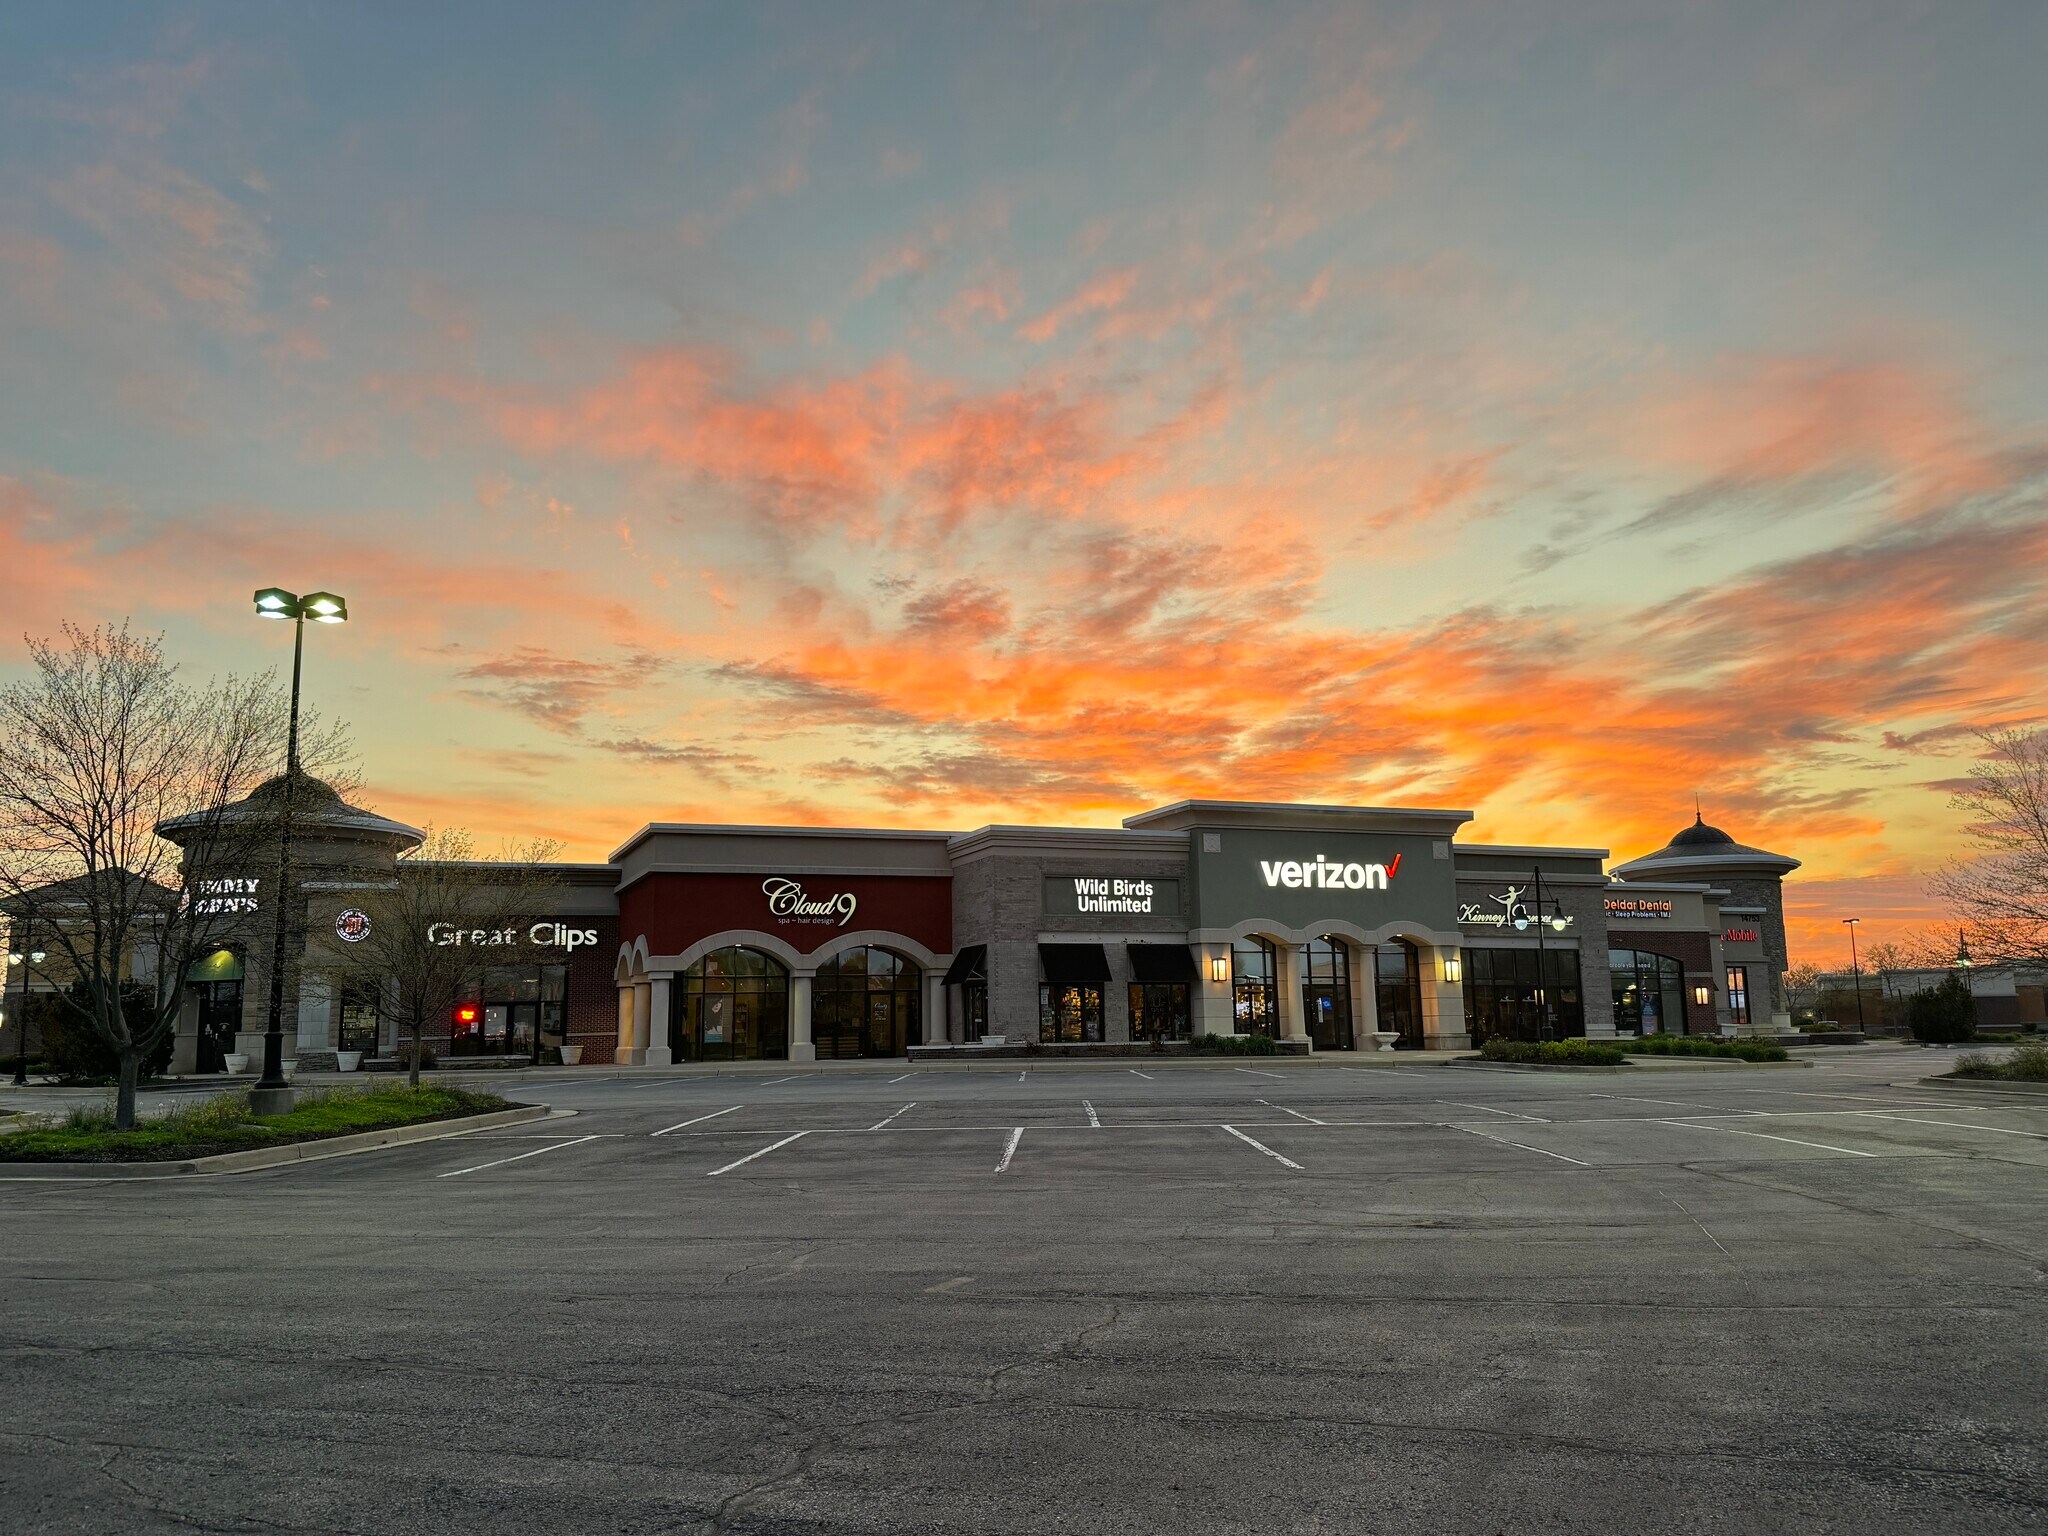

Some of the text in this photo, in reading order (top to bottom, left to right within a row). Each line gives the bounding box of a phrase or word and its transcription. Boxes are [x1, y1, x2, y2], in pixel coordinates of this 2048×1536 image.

[1260, 854, 1388, 890] verizon
[762, 877, 839, 915] Cloud
[1074, 878, 1154, 896] Wild Birds
[1077, 895, 1152, 913] Unlimited
[1603, 898, 1672, 911] Deldar Dental
[812, 917, 835, 926] design
[1456, 903, 1506, 928] Kinney
[427, 921, 599, 953] Great Clips
